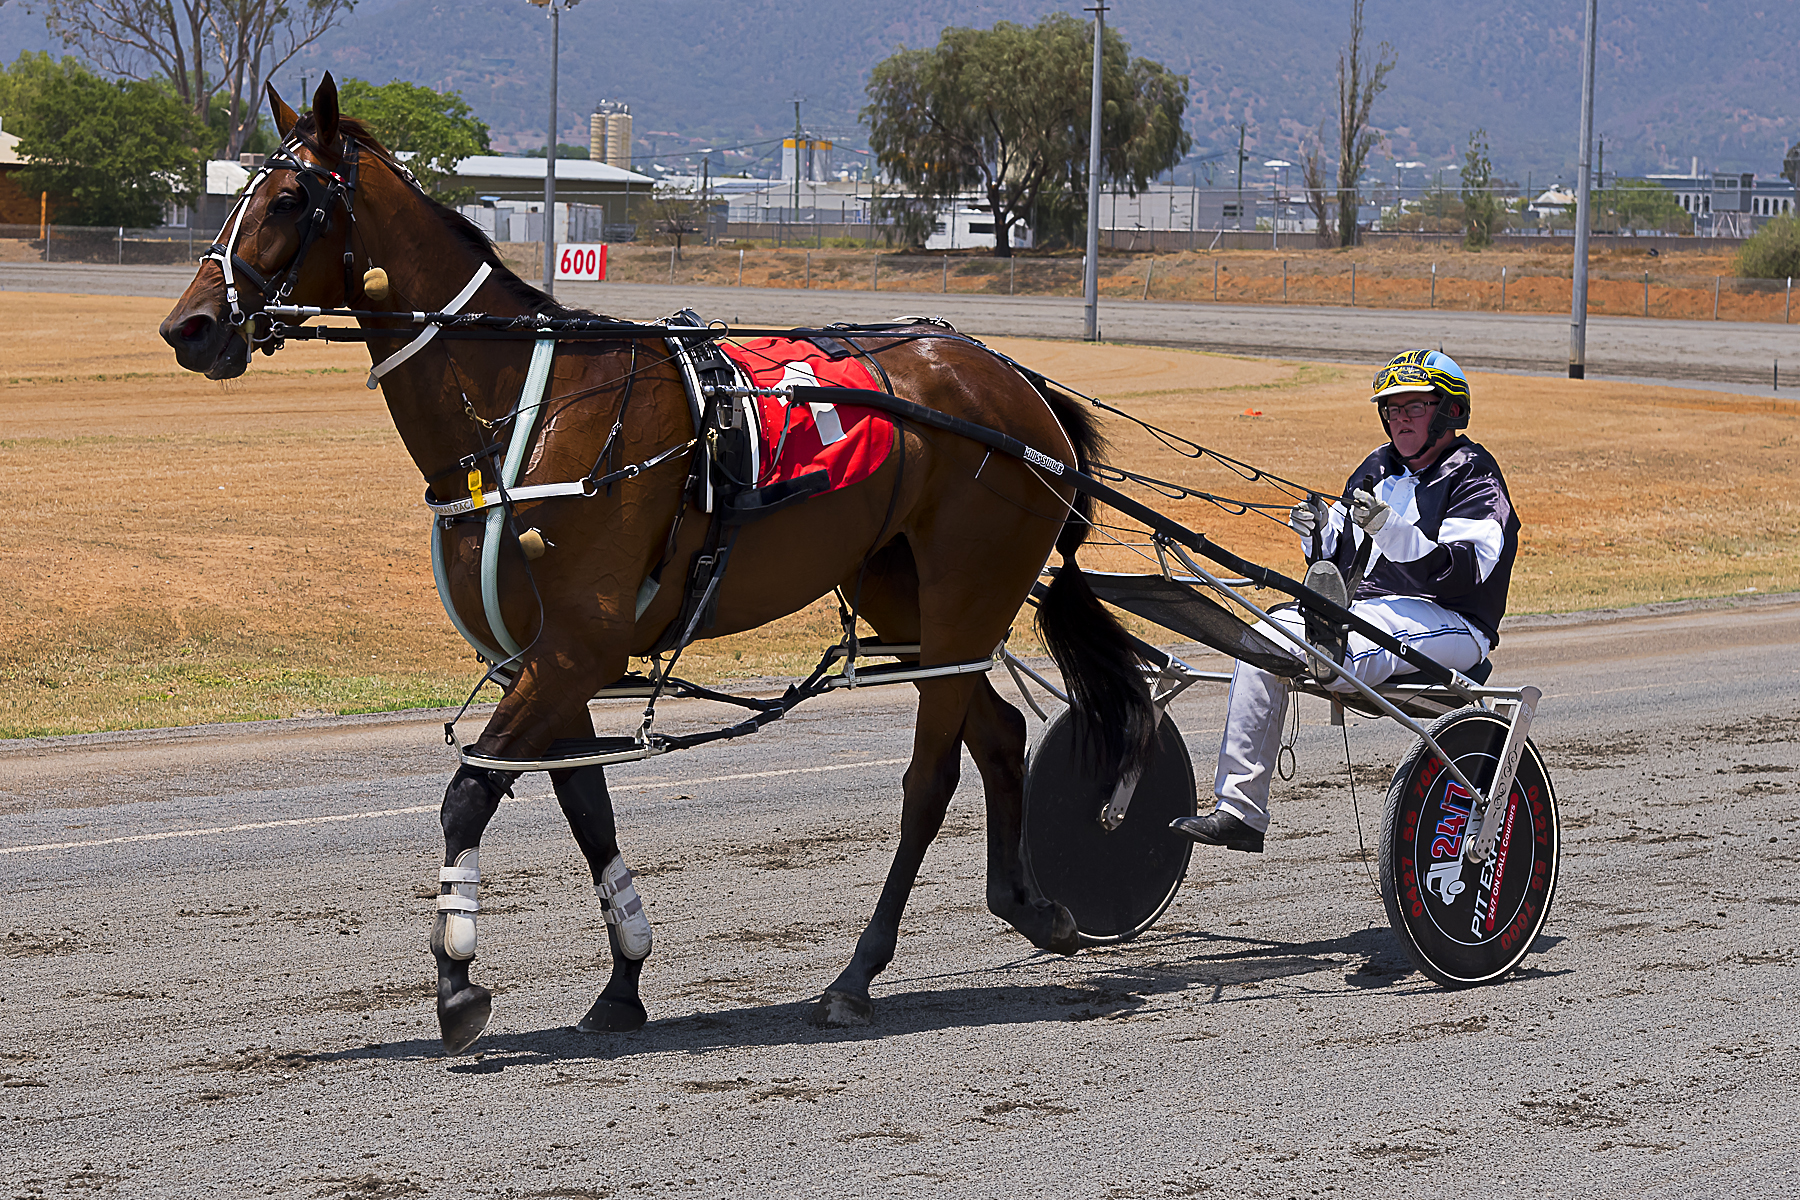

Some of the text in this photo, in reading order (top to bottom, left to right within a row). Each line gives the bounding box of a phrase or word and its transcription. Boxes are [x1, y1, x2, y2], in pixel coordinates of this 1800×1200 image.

[561, 249, 596, 275] 600
[1402, 810, 1417, 842] 55
[1431, 780, 1473, 859] 24/7
[1401, 856, 1424, 918] 0427
[1488, 803, 1516, 920] 24/7 ON CALL Couriers
[1501, 785, 1548, 950] 0427 55 7000
[1471, 889, 1488, 939] PIT
